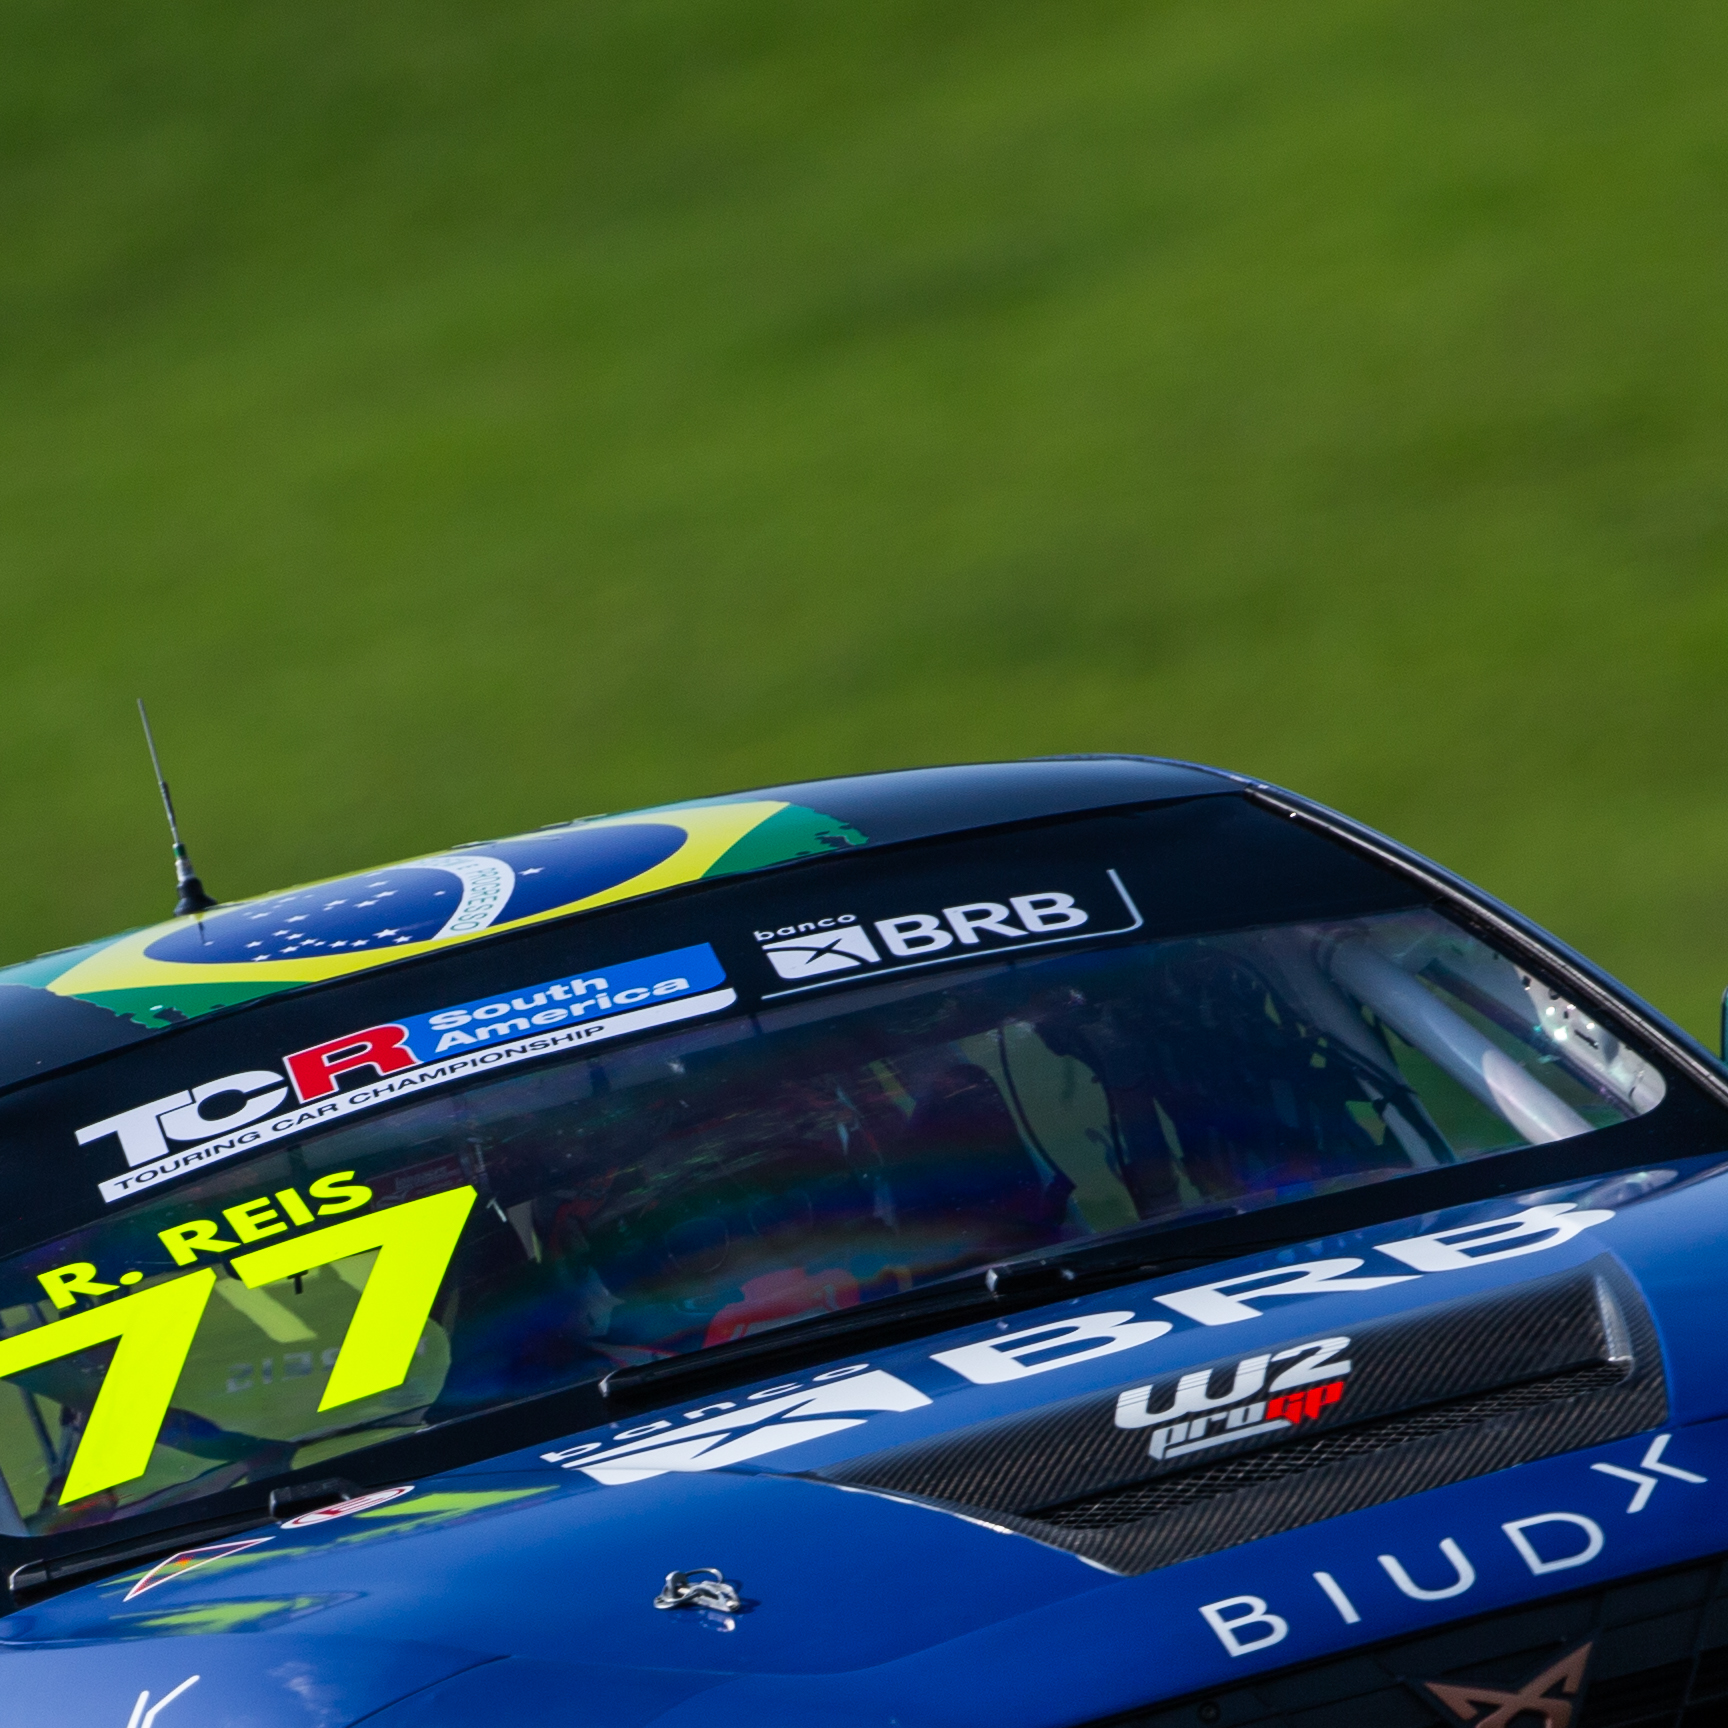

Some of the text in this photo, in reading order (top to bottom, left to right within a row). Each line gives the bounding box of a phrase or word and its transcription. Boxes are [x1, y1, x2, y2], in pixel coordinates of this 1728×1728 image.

[754, 914, 857, 942] banco
[874, 891, 1089, 957] BRB
[428, 975, 609, 1031] South
[435, 976, 691, 1053] America
[74, 1022, 420, 1168] TCR
[113, 1024, 606, 1192] TOURING CAR CHAMPIONSHIP
[37, 1261, 144, 1310] R.
[158, 1170, 373, 1266] REIS
[929, 1202, 1617, 1385] BRB
[539, 1362, 870, 1465] banco
[1197, 1433, 1709, 1658] BIUDX
